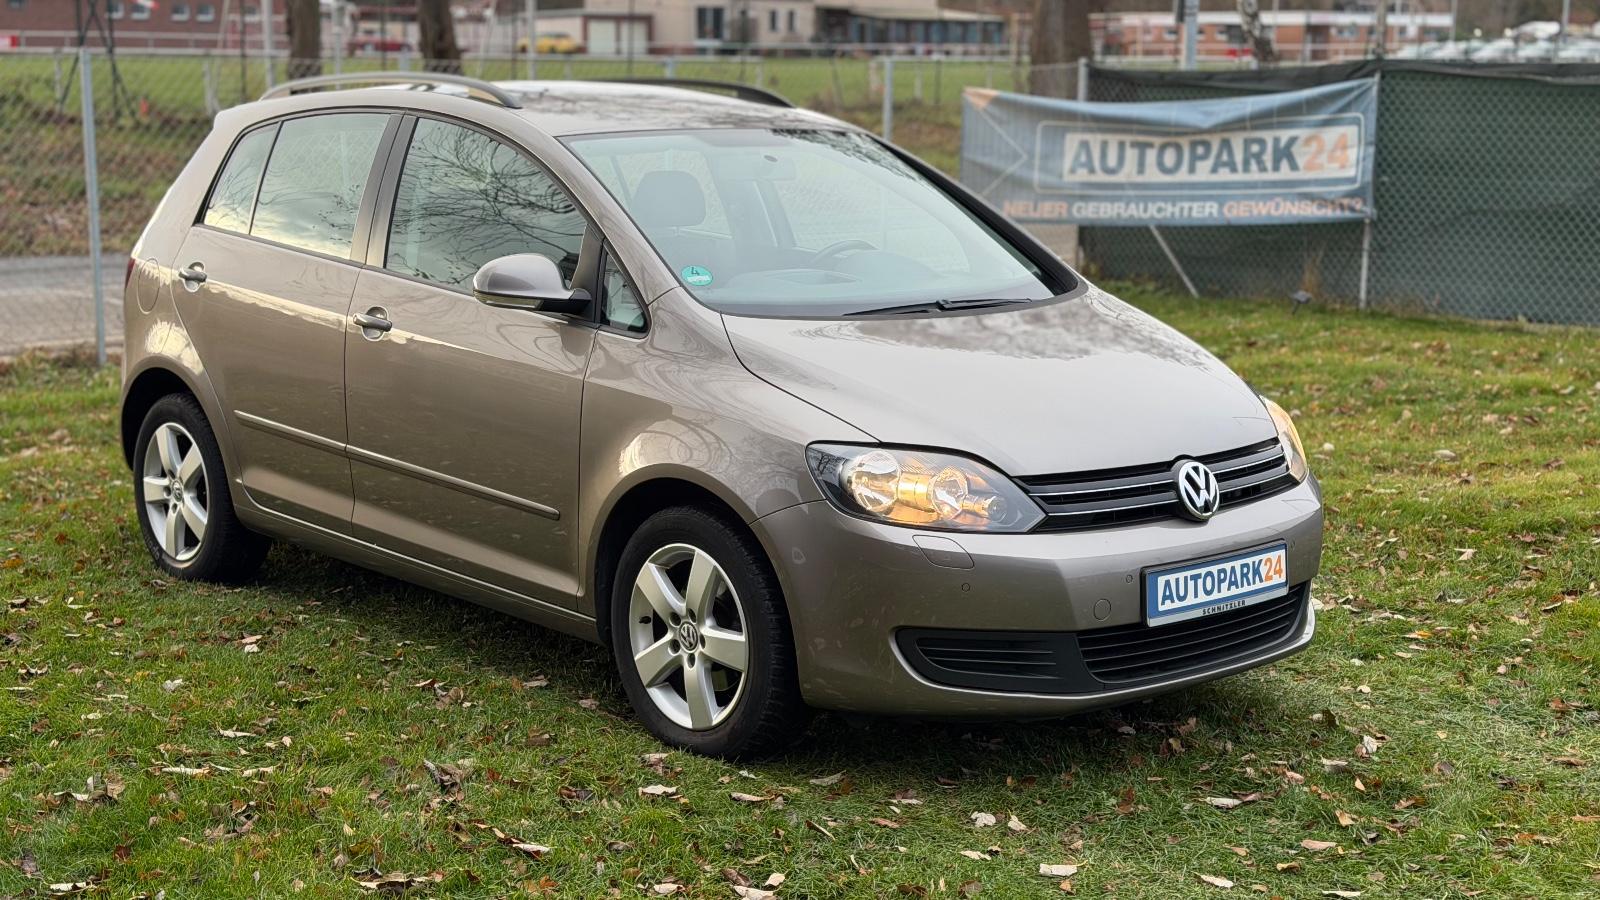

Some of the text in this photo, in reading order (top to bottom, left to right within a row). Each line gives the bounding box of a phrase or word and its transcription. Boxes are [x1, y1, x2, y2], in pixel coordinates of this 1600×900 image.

[1069, 133, 1350, 175] AUTOPARK24
[1072, 201, 1219, 218] GEBRAUCHTER
[1160, 554, 1283, 606] AUTOPARK24
[1202, 600, 1246, 615] SCHNITZLER
